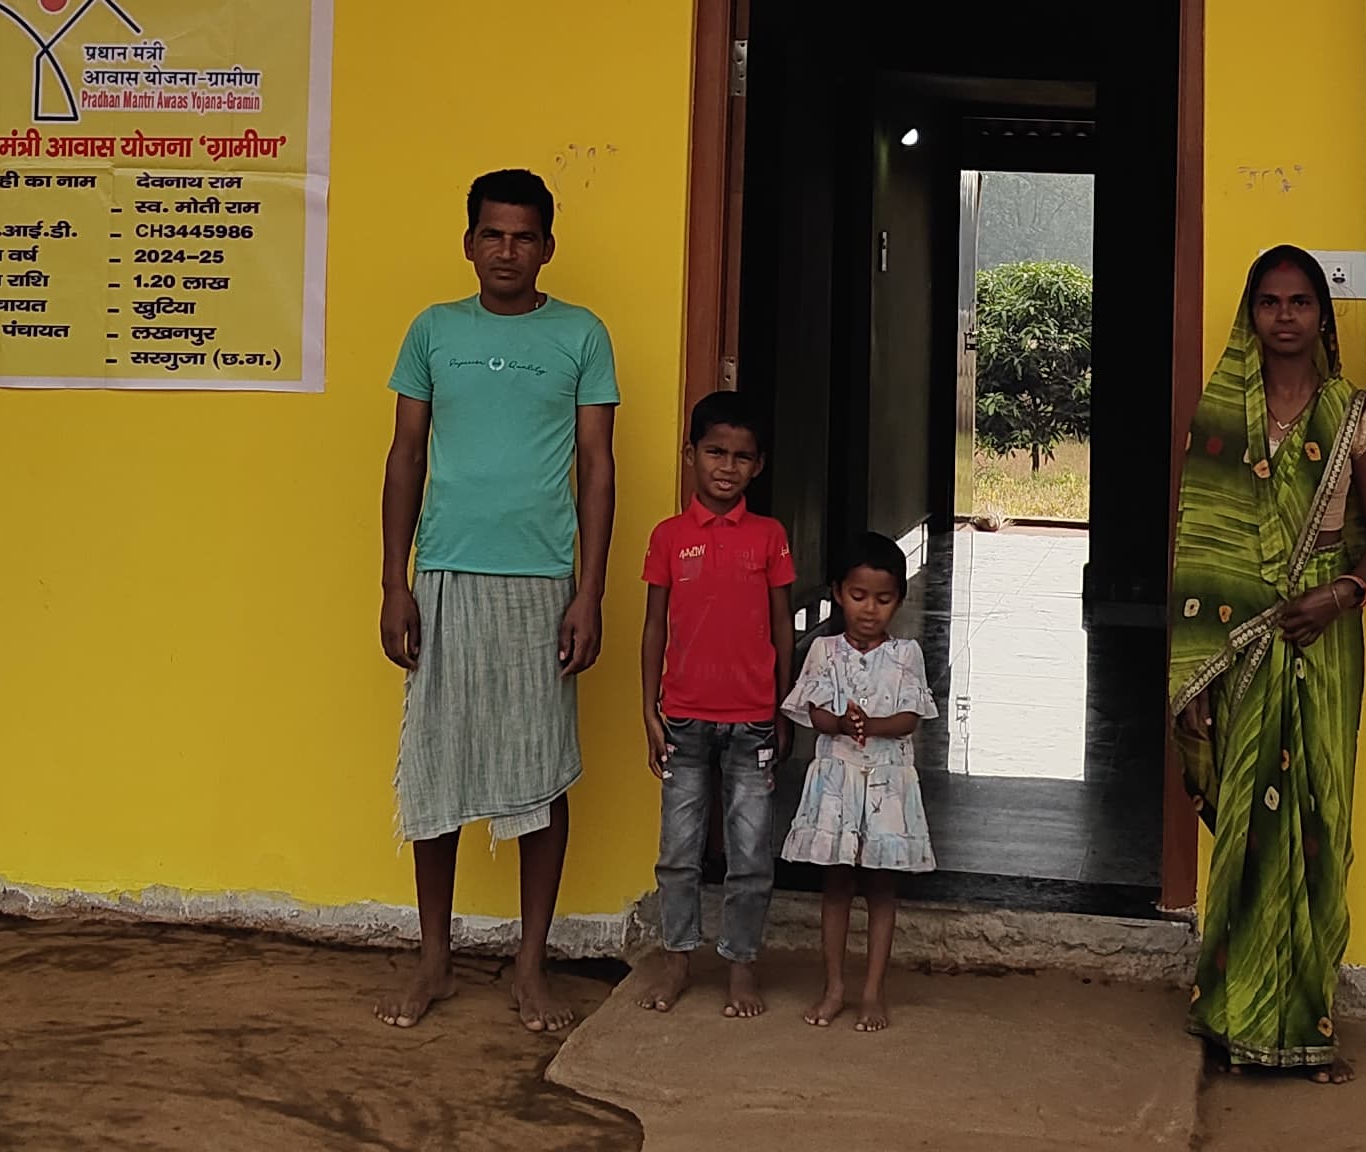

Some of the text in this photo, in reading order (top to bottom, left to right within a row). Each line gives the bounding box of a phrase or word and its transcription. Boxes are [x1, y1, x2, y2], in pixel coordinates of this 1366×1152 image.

[84, 41, 165, 61] प्रधान मंत्री
[84, 70, 140, 87] आवास
[82, 90, 260, 113] Pradhan Mantri Awaas Yojana-Gramin
[45, 137, 116, 157] आवास
[120, 129, 193, 158] योजना
[24, 176, 52, 188] का
[56, 176, 97, 188] नाम
[136, 172, 204, 189] देवनाथ
[208, 176, 243, 189] राम
[135, 201, 169, 214] स्व.
[175, 197, 221, 214] मोती
[225, 202, 261, 214] राम
[135, 224, 254, 239] CH3445986
[8, 245, 39, 262] वर्ष
[133, 249, 224, 264] 2024-25
[7, 270, 50, 287] राशि
[133, 275, 175, 289] 1.20
[182, 277, 230, 289] लाख
[132, 297, 196, 319] खुटिया
[2, 320, 70, 337] पंचायत
[131, 326, 217, 346] लखनपुर
[131, 352, 207, 370] सरगुजा
[213, 348, 281, 371] (छ.ग.)
